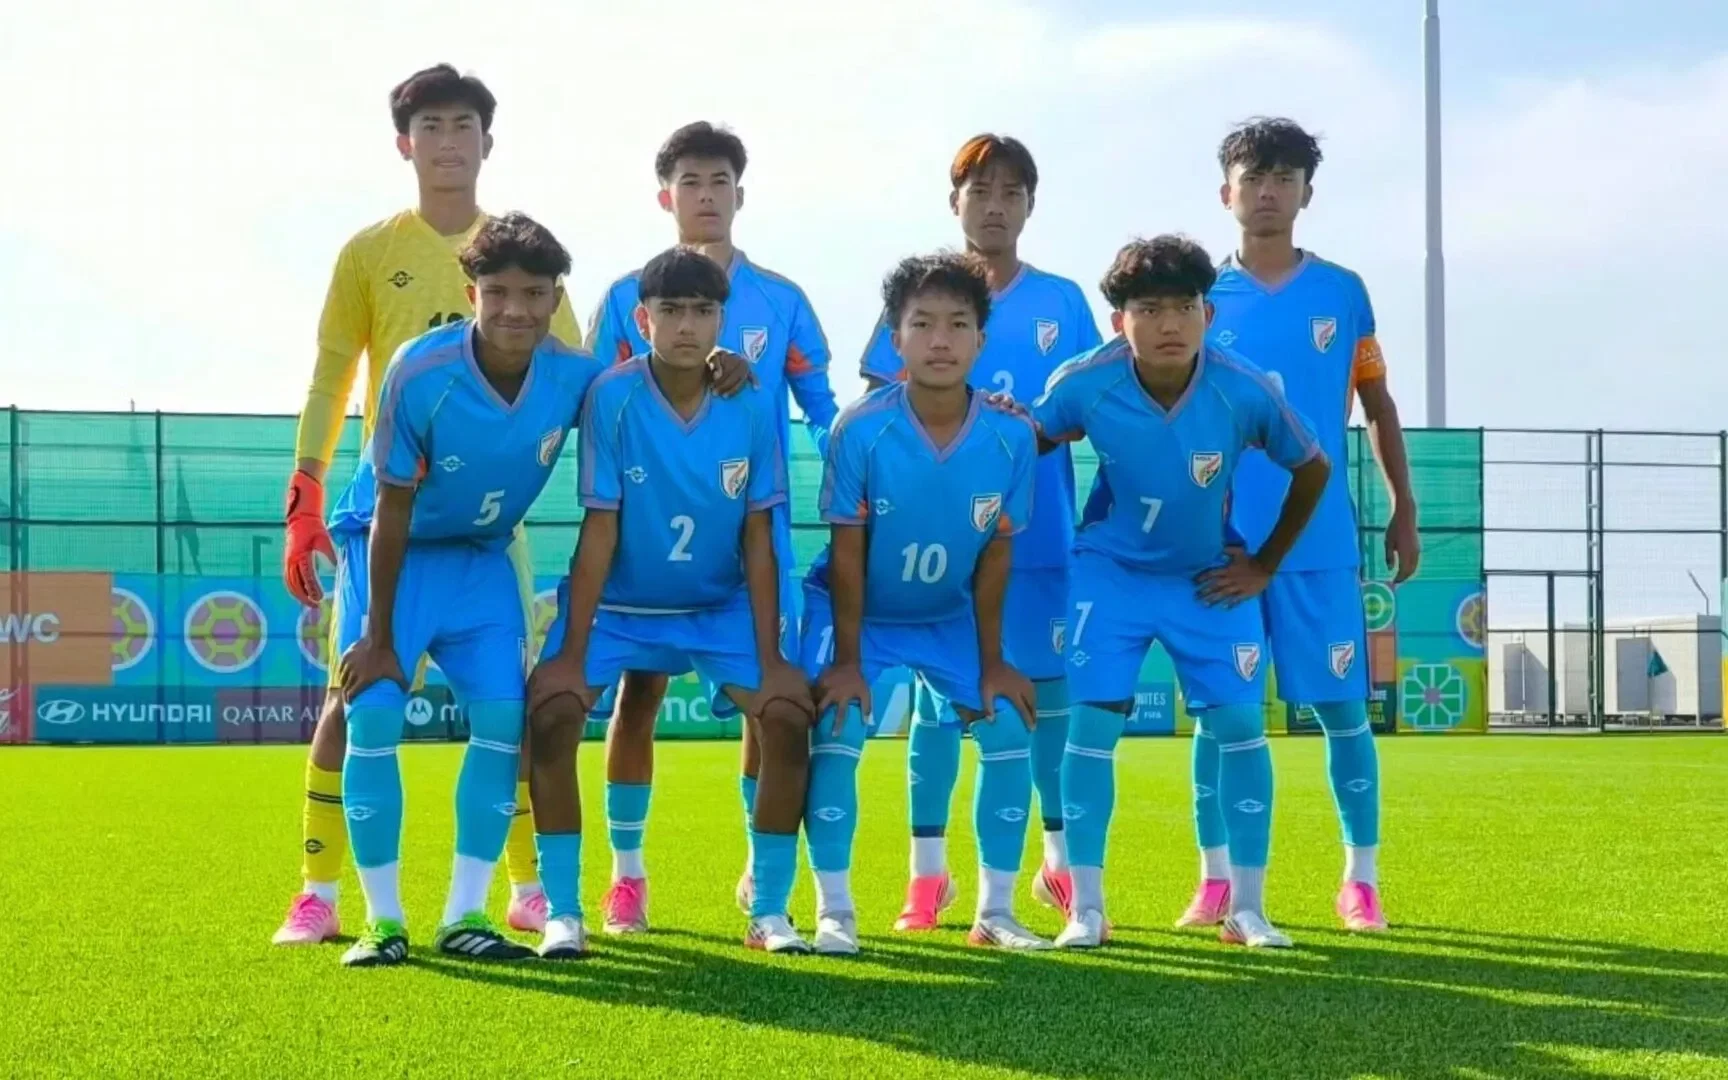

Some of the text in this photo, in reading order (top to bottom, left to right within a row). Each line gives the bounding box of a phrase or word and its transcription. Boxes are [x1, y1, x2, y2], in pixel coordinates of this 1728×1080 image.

[473, 489, 505, 526] 5
[1140, 496, 1163, 534] 7
[667, 515, 695, 561] 2
[901, 542, 948, 584] 10
[1071, 601, 1094, 646] 7
[815, 625, 835, 665] 1
[92, 704, 212, 723] HYUNDAI
[223, 705, 294, 726] QATAR
